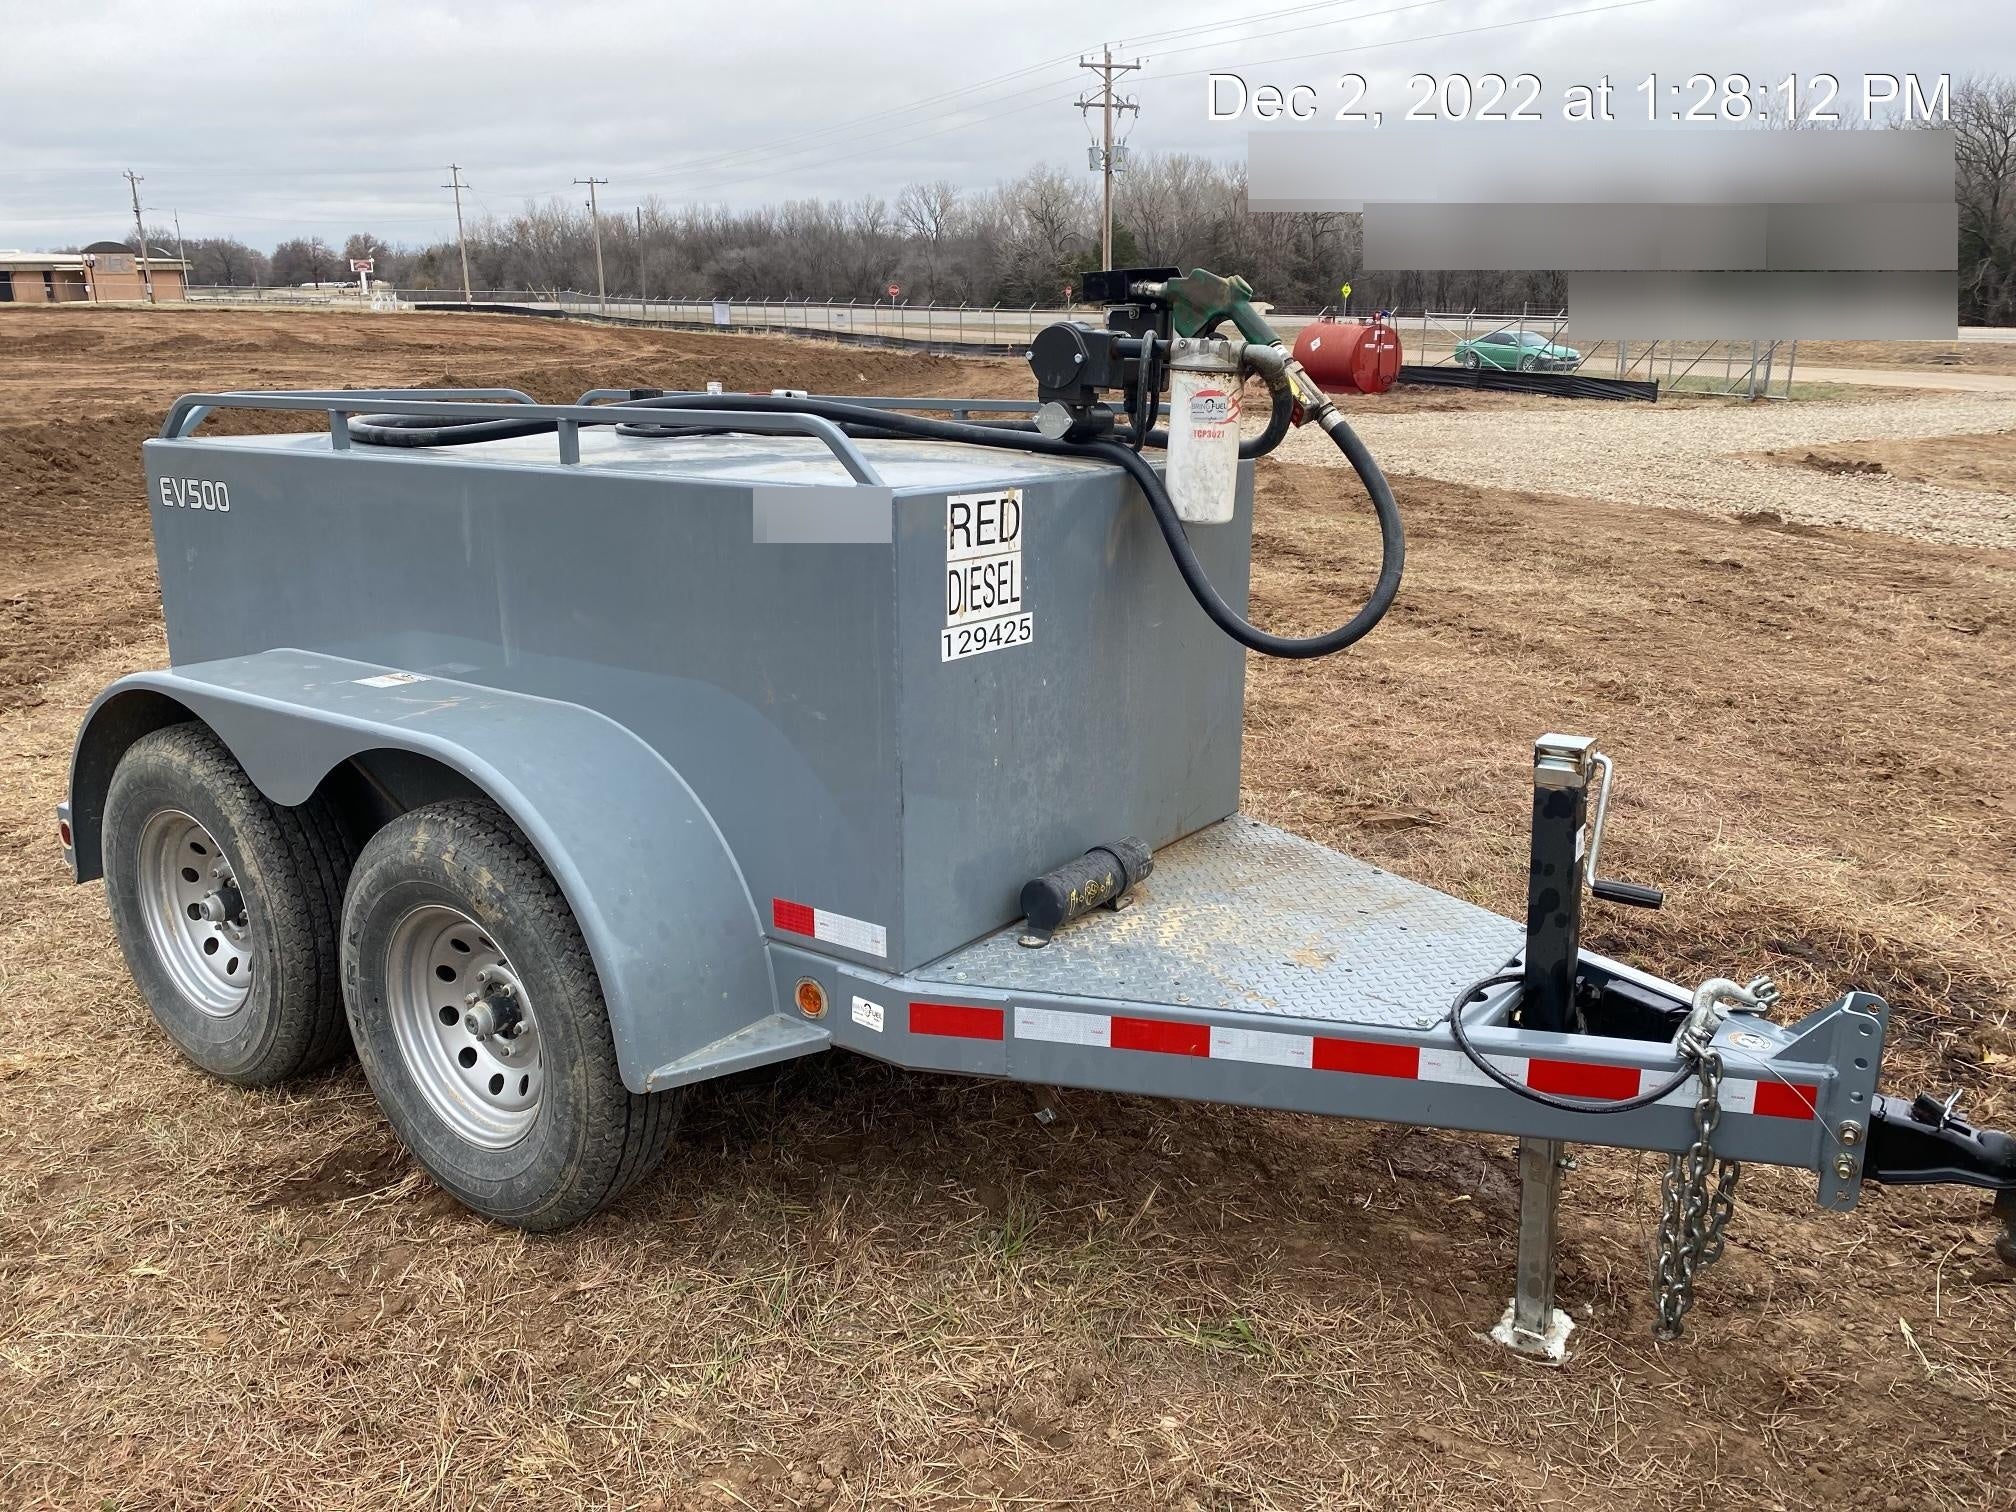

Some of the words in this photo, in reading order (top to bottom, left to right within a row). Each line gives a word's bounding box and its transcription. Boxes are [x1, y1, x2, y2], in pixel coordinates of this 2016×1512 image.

[159, 476, 230, 512] EV500
[950, 498, 1020, 550] RED
[948, 559, 1020, 616] DIESEL
[943, 617, 1032, 658] 129425
